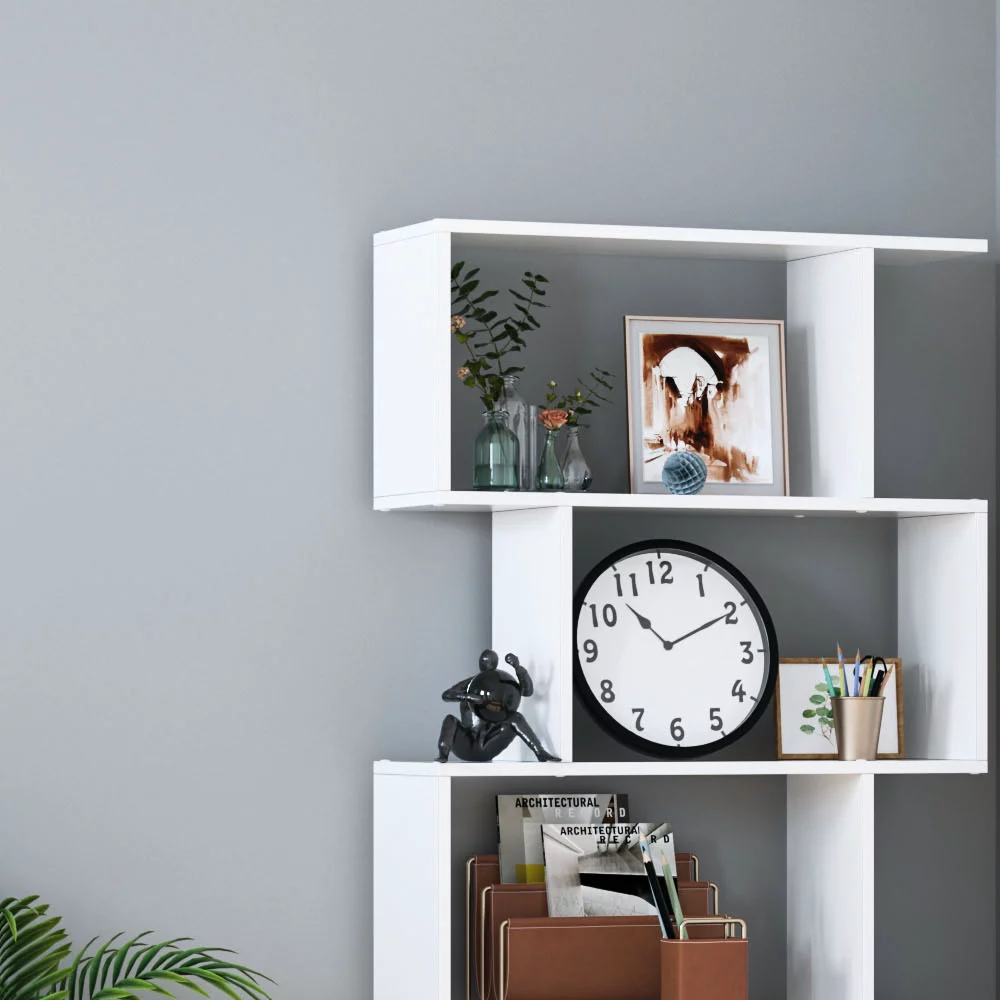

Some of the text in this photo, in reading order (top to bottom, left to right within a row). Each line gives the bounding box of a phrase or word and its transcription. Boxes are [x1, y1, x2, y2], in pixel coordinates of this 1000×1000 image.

[646, 560, 674, 584] 12
[614, 574, 638, 596] 11
[696, 574, 705, 597] 1
[589, 604, 618, 628] 10
[724, 601, 738, 624] 2
[583, 639, 598, 663] 9
[740, 641, 754, 664] 3
[600, 679, 616, 703] 8
[731, 680, 746, 702] 4
[632, 708, 645, 731] 7
[670, 718, 685, 741] 6
[709, 708, 723, 731] 5
[515, 798, 600, 808] ARCHITECTURAL
[554, 808, 626, 818] REORD
[600, 835, 670, 844] RECRD
